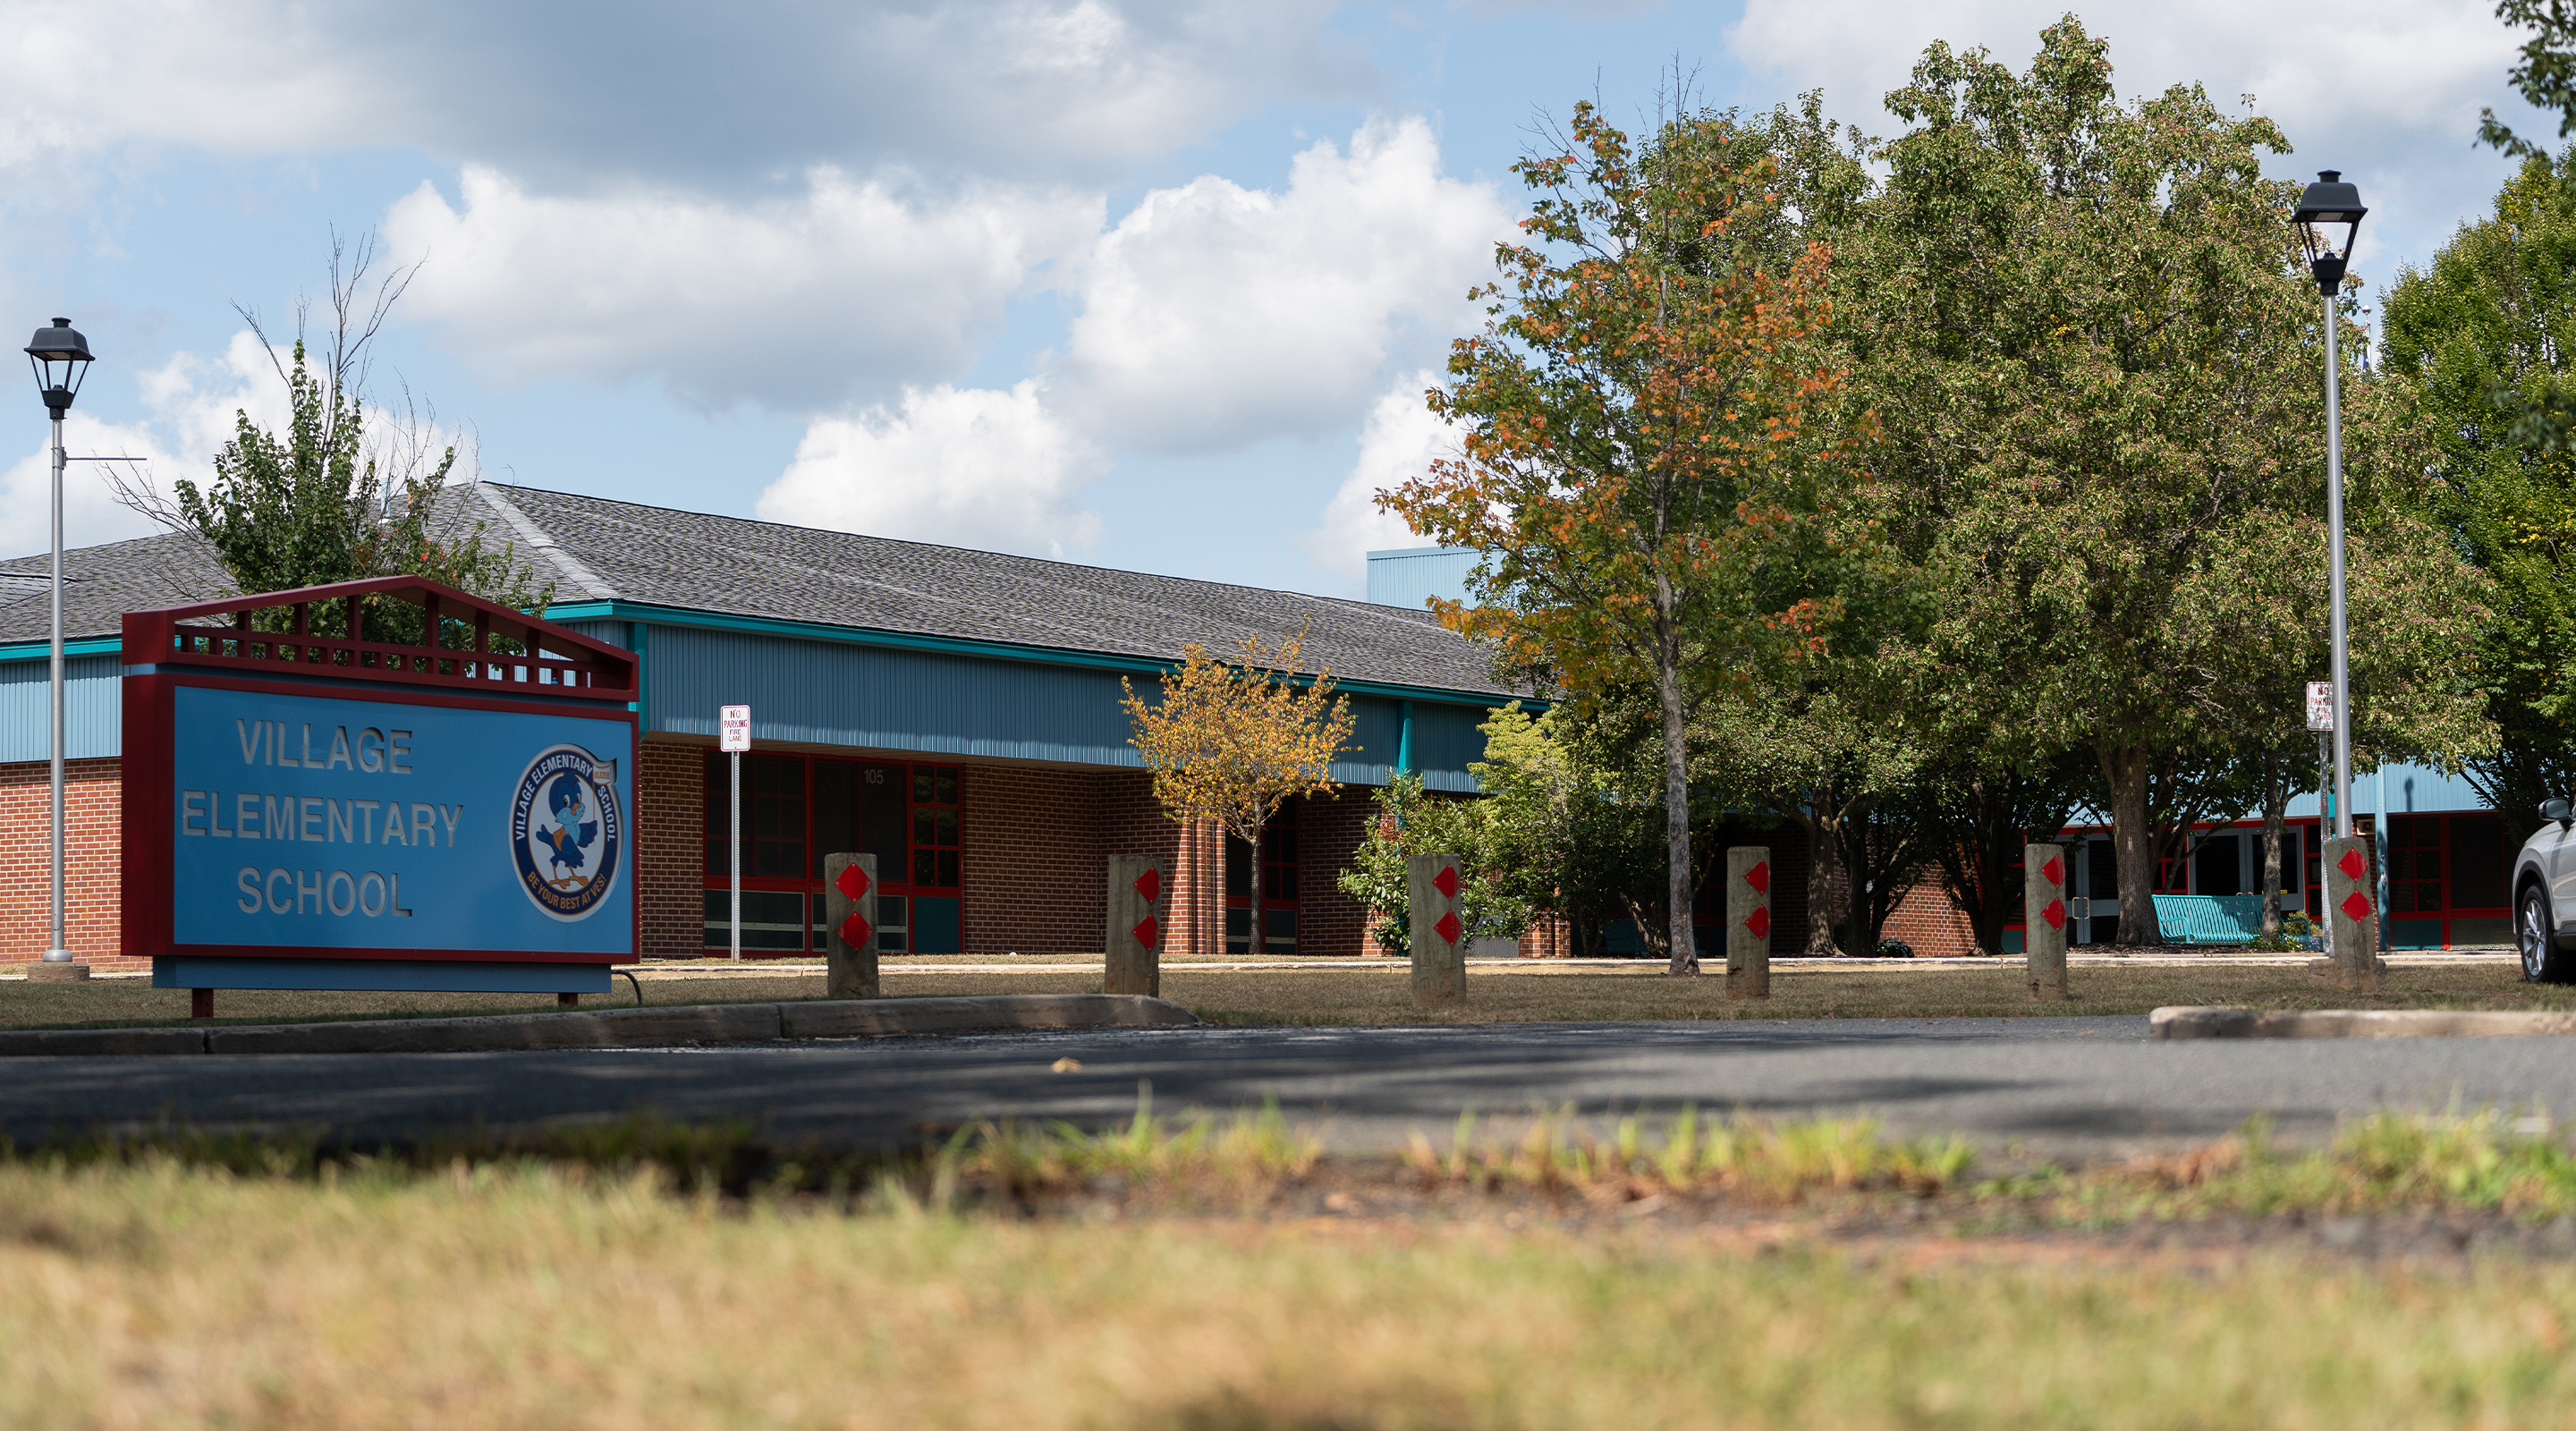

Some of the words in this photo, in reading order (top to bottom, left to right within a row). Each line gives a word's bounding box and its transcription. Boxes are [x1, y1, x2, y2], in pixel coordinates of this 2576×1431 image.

[2310, 698, 2333, 706] PARKIN
[2318, 687, 2329, 695] NO
[724, 719, 747, 728] PARKING
[730, 710, 741, 718] NO
[236, 718, 413, 775] VILLAGE
[864, 768, 884, 784] 105
[516, 781, 536, 841] VILLAGE
[531, 754, 593, 784] ELEMENTARY
[597, 785, 616, 843] SCHOOL
[182, 789, 464, 848] ELEMENTARY
[237, 866, 413, 918] SCHOOL
[527, 870, 540, 889] BE
[538, 883, 559, 908] YOUR
[559, 895, 580, 910] BEST
[581, 890, 591, 906] AT
[589, 873, 607, 897] VES!
